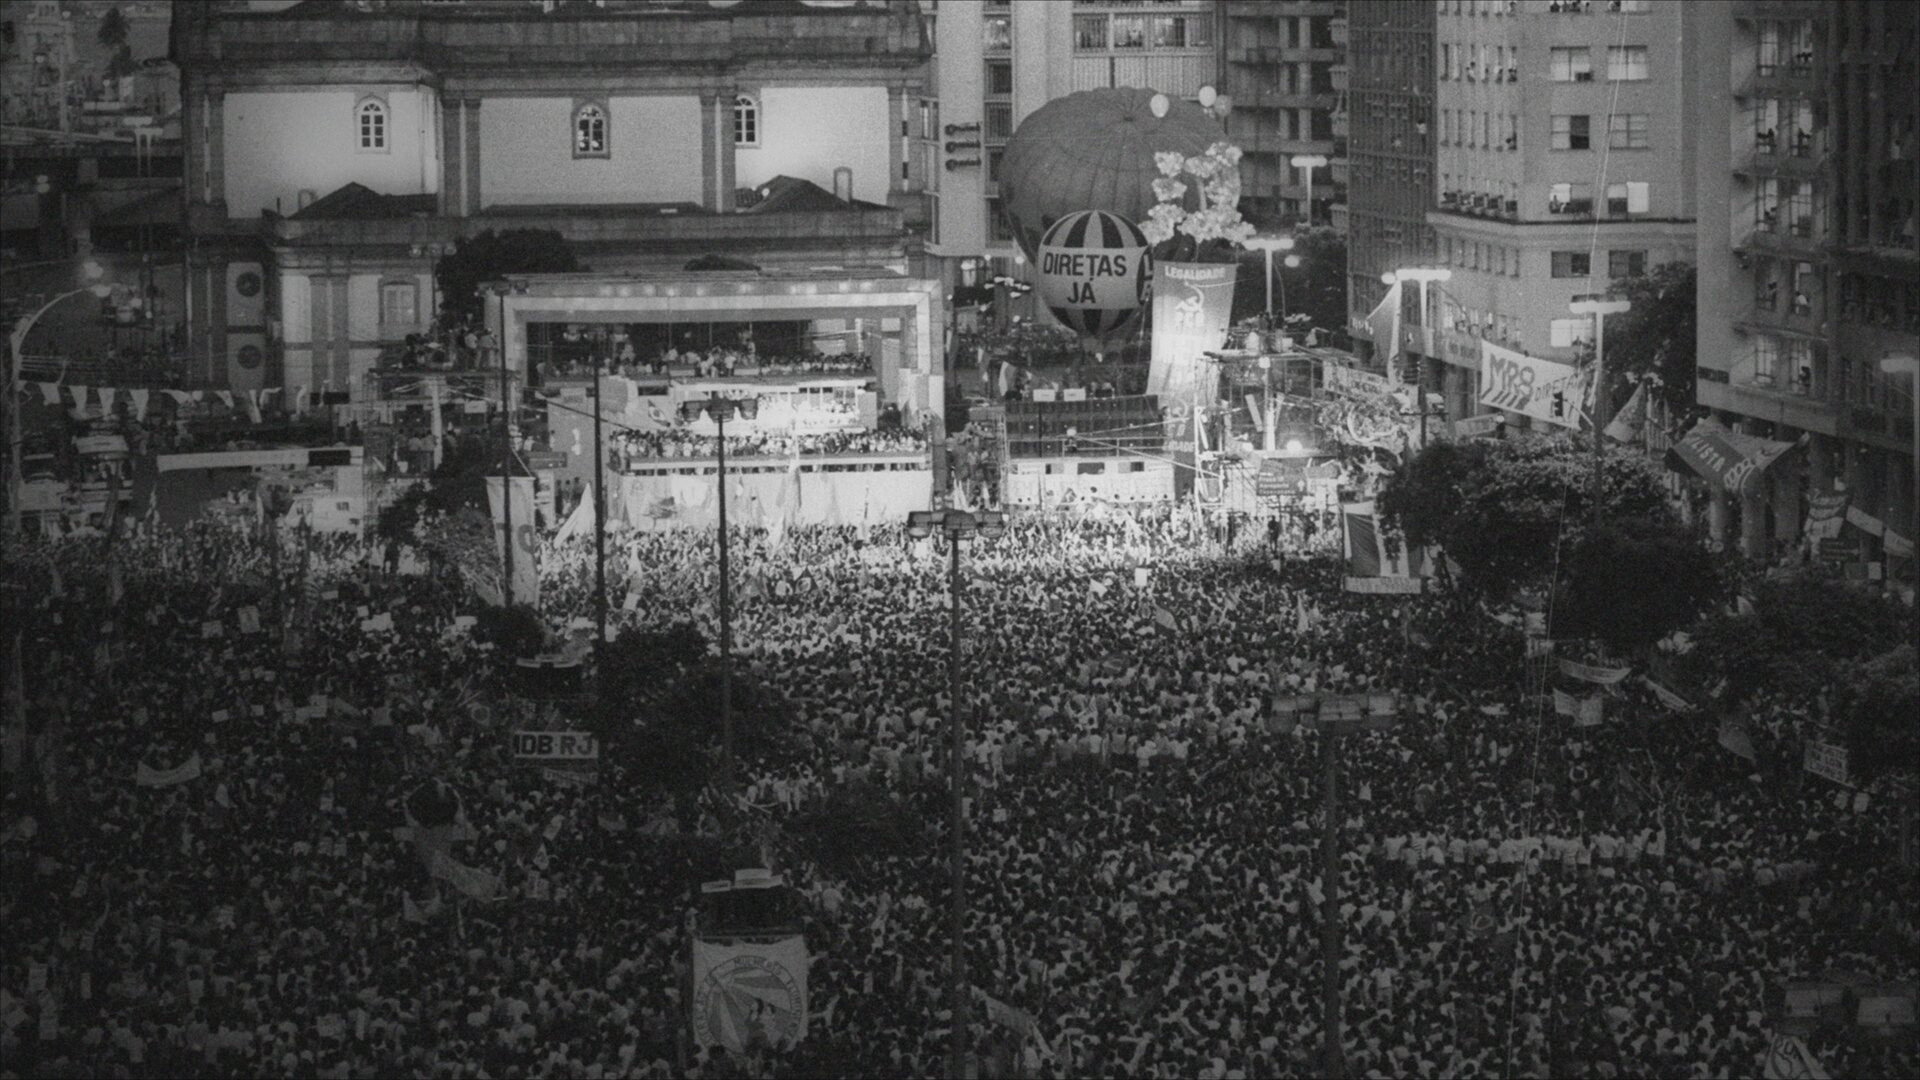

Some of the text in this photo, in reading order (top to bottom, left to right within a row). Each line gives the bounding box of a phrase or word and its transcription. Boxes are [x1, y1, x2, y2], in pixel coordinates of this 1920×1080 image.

[1043, 252, 1127, 277] DIRETAS
[1067, 277, 1096, 304] JÁ
[1489, 353, 1534, 402] MR8
